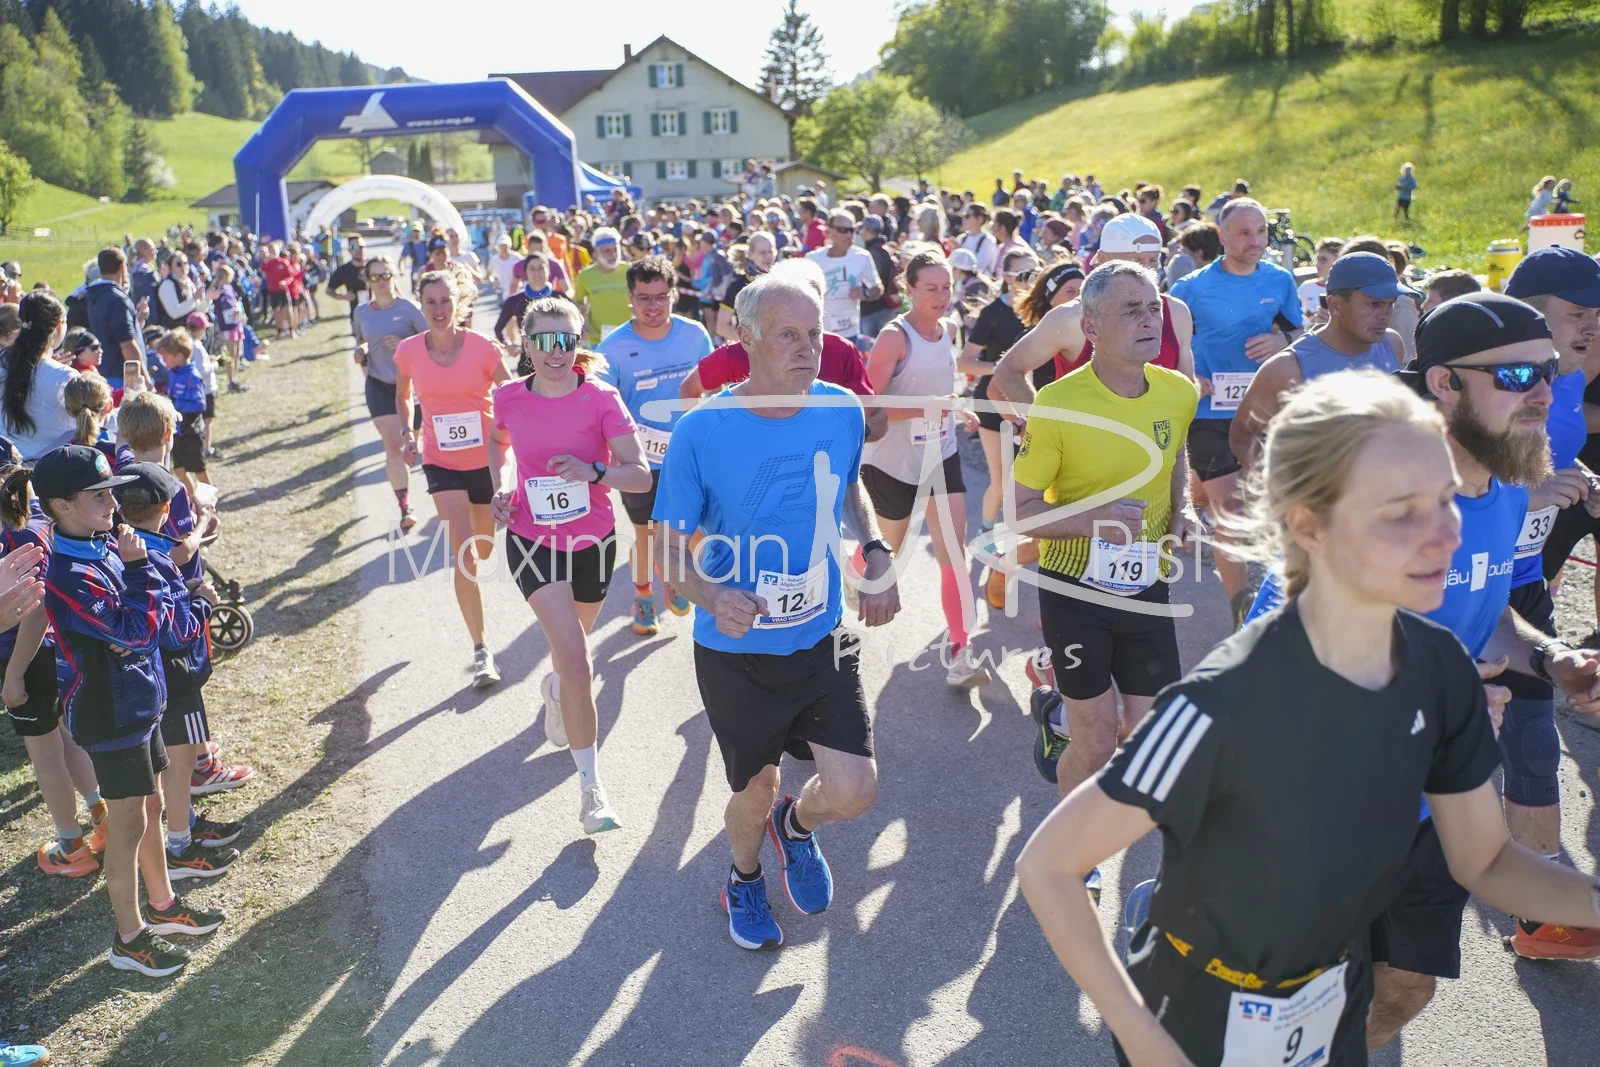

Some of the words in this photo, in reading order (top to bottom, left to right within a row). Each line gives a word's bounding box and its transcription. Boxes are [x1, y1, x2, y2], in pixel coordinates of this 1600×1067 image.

[1224, 386, 1248, 399] 127
[449, 425, 467, 440] 59
[645, 440, 668, 454] 118
[546, 492, 569, 511] 16
[1529, 515, 1550, 540] 33
[1109, 560, 1143, 582] 119
[777, 585, 816, 614] 124
[1283, 1026, 1303, 1064] 9
